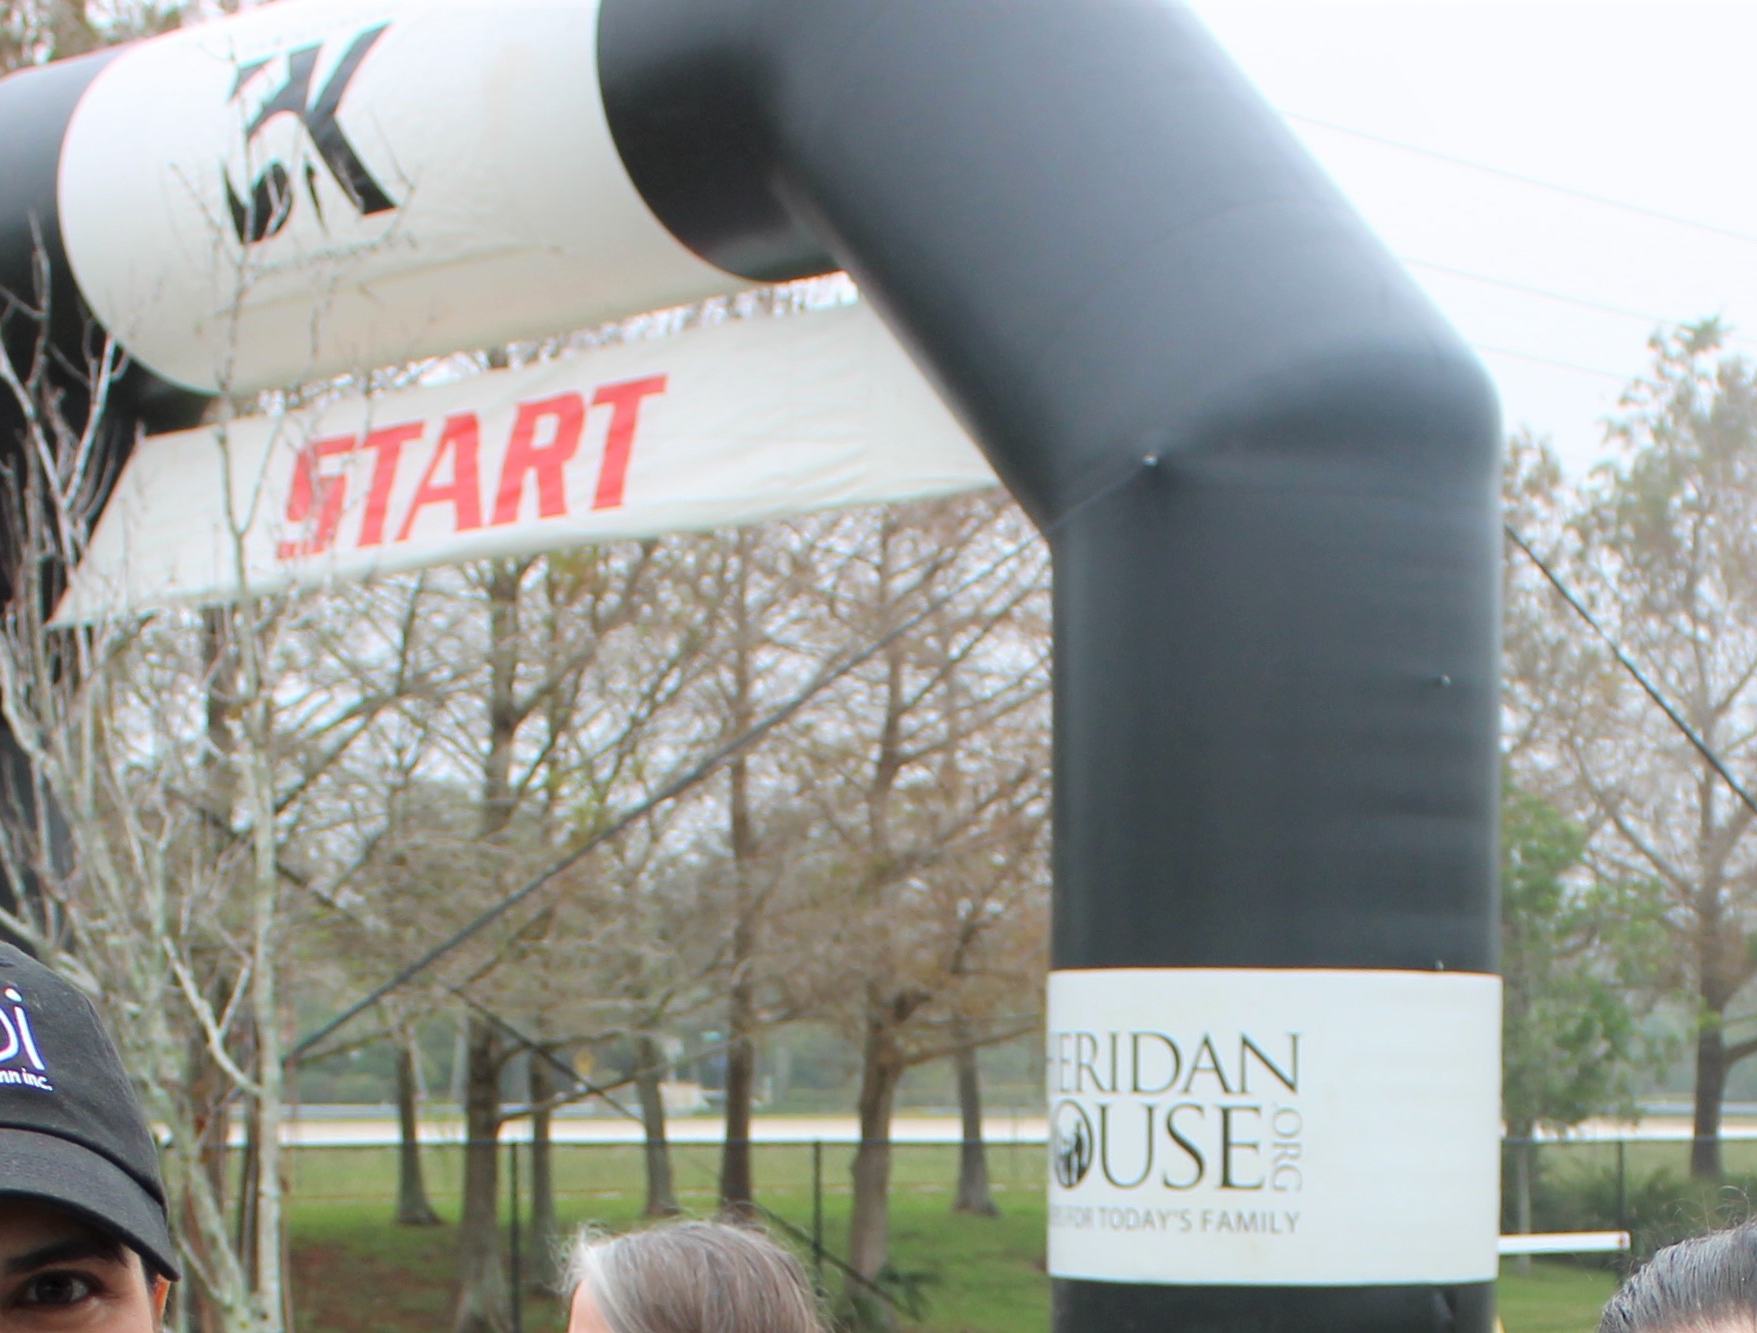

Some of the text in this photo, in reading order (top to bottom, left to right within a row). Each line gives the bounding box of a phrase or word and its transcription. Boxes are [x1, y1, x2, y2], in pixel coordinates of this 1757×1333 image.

[276, 374, 667, 560] START
[1052, 1099, 1267, 1190] OUSE
[1099, 1207, 1193, 1233] TODAY'S
[1200, 1209, 1300, 1234] FAMILY
